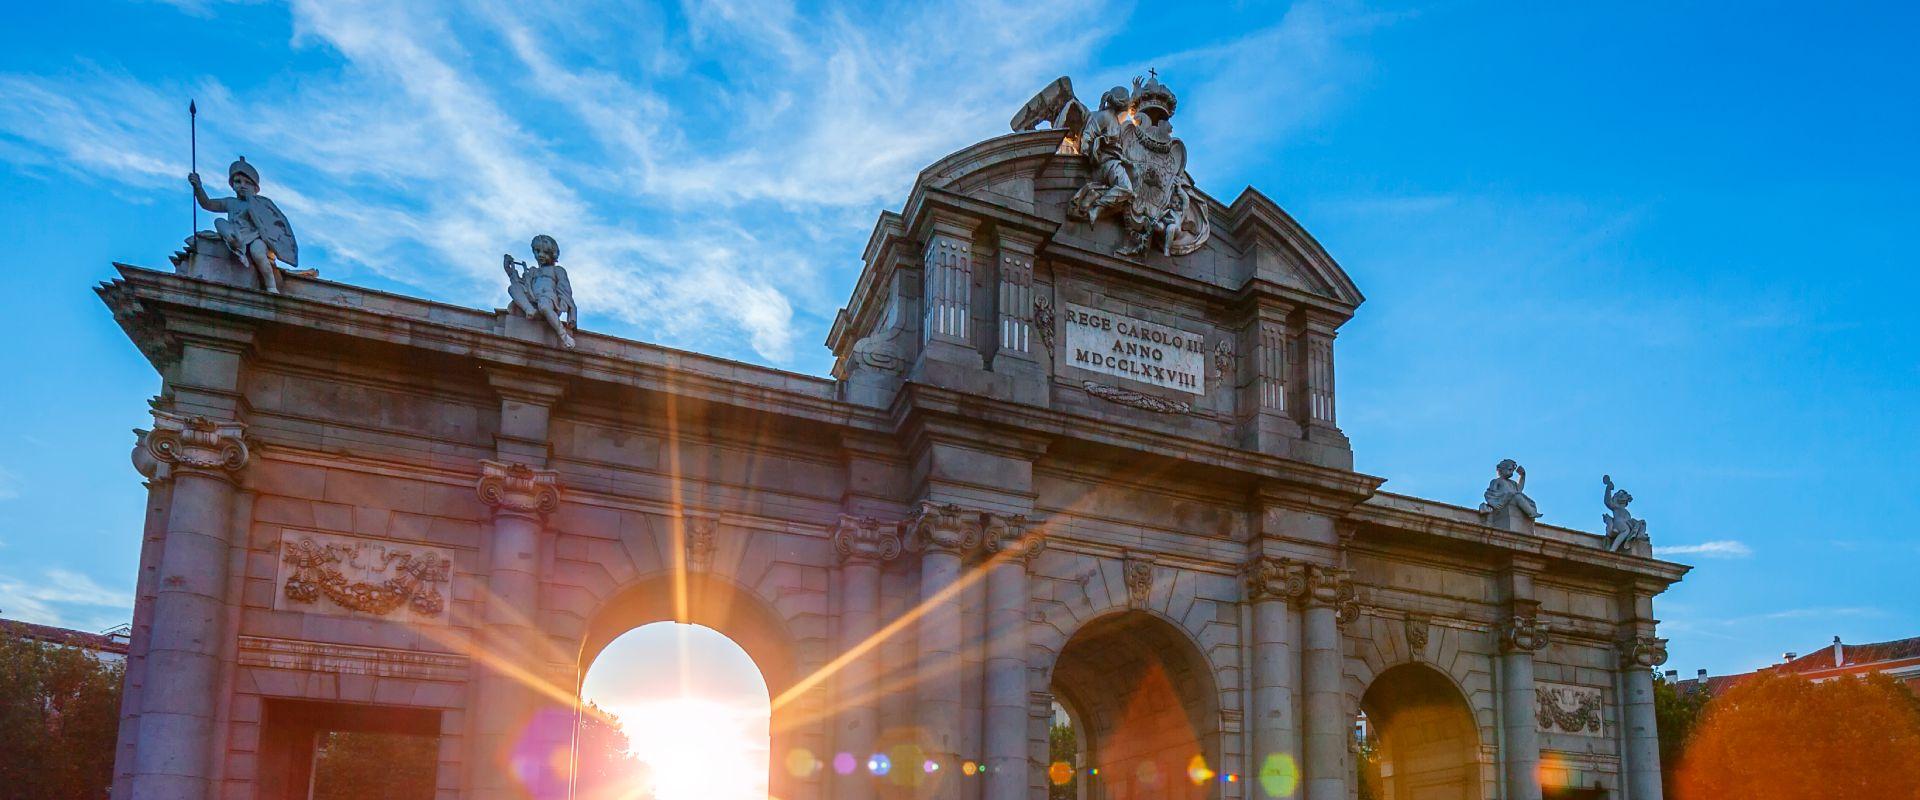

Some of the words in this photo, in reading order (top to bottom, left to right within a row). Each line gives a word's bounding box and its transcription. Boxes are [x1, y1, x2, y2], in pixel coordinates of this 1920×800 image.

[1065, 309, 1111, 331] REGE
[1117, 322, 1182, 349] CAROLO
[1187, 339, 1205, 354] III
[1112, 339, 1163, 360] ANNO
[1076, 348, 1196, 387] MDCCLXXVIII
